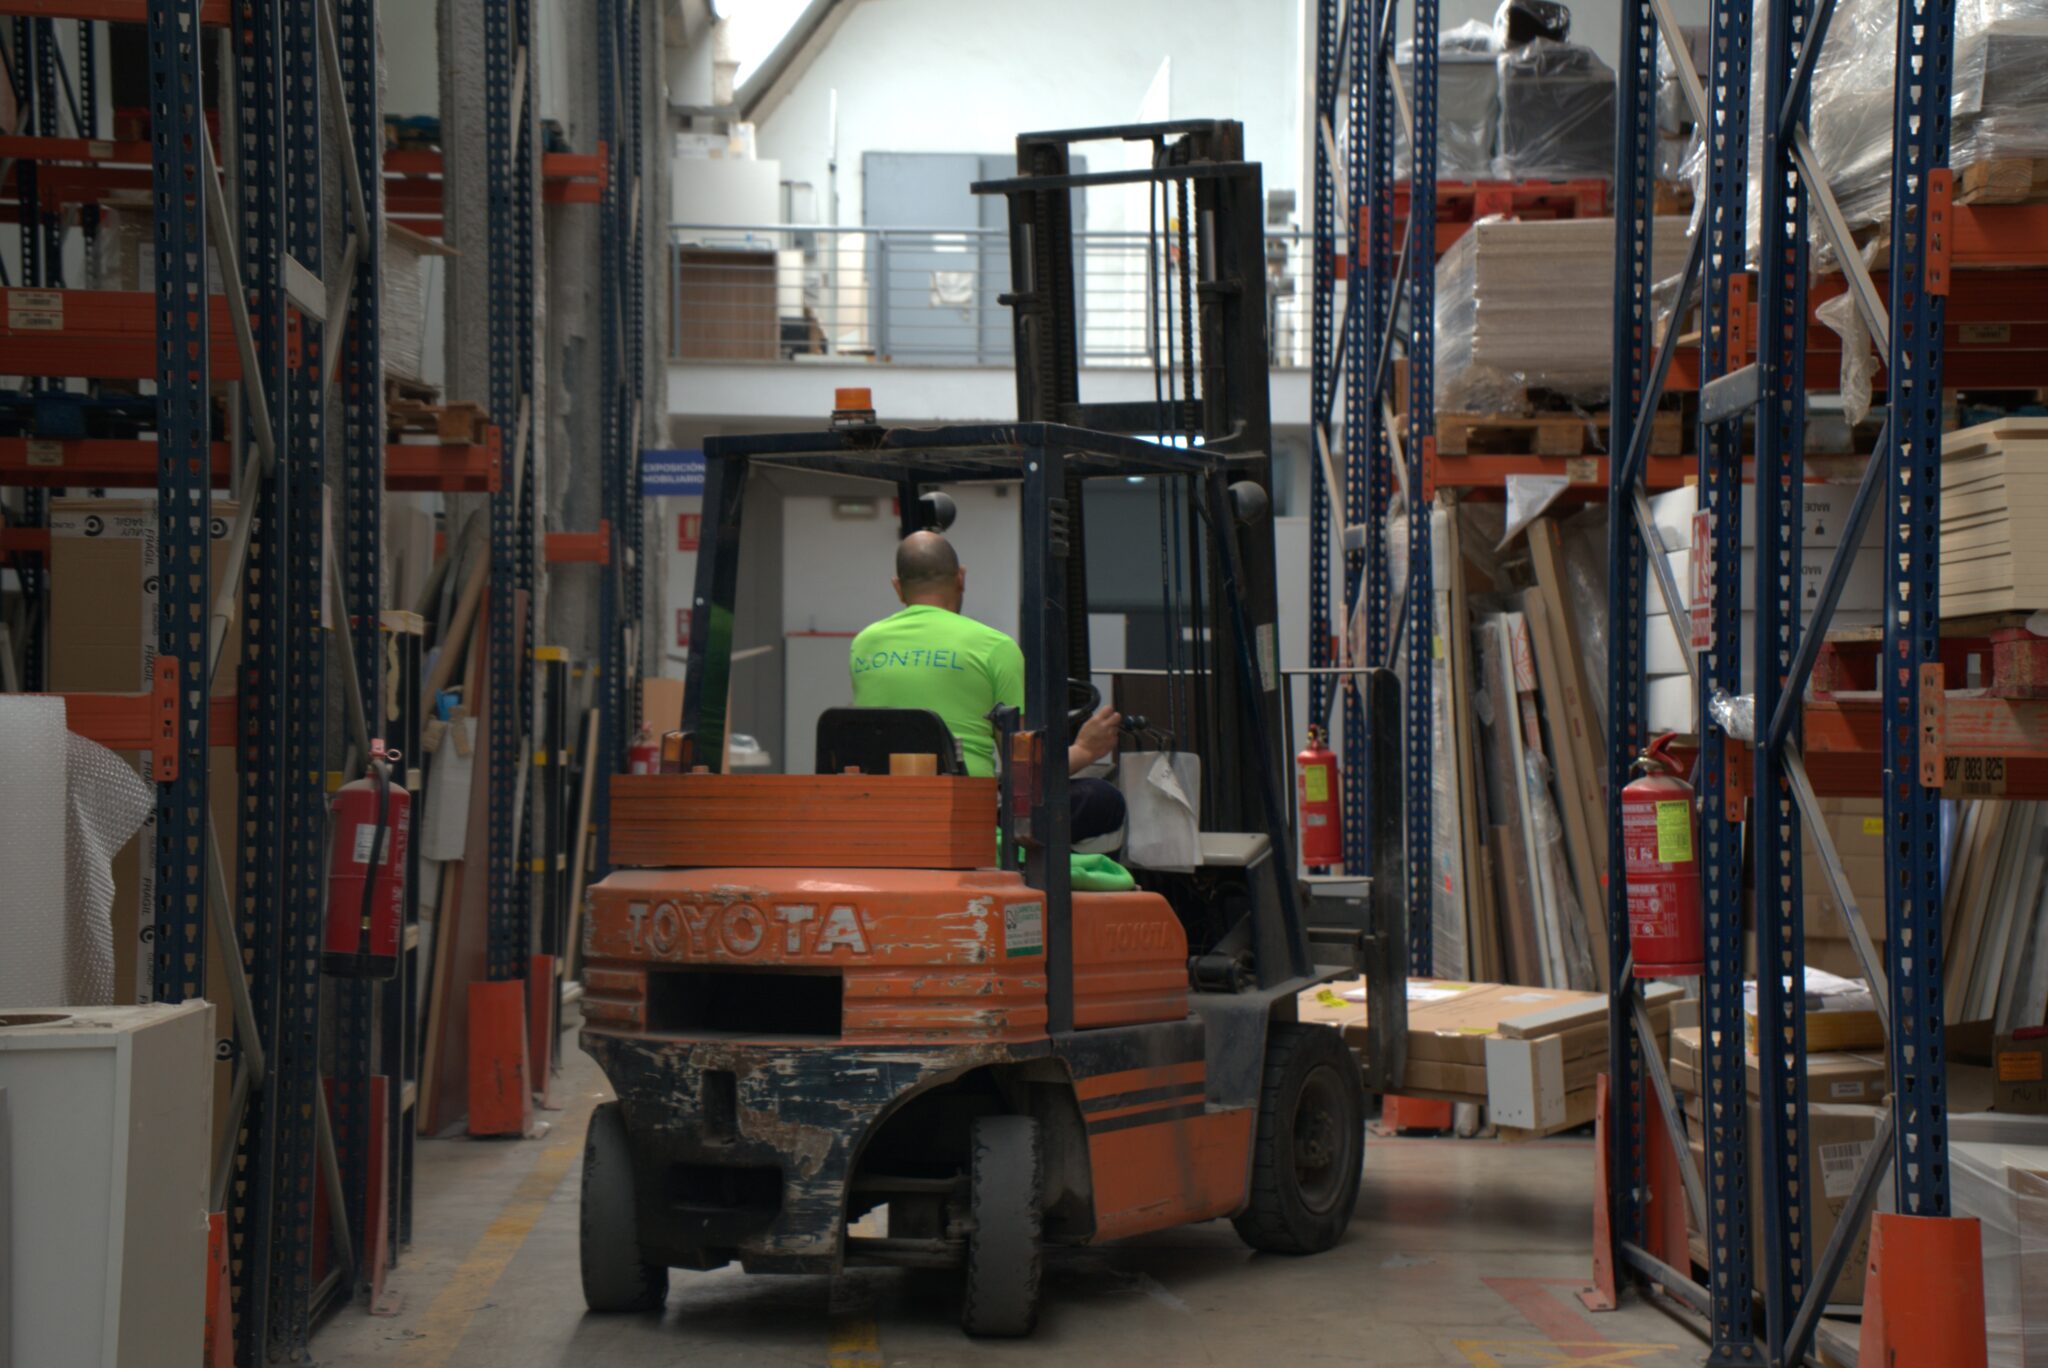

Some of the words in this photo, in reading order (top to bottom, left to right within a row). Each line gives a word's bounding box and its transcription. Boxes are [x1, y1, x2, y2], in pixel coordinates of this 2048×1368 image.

[1804, 502, 1831, 513] MADE
[1800, 565, 1822, 576] MAD
[142, 877, 153, 916] FRAGIL
[627, 900, 872, 956] TOYOTA
